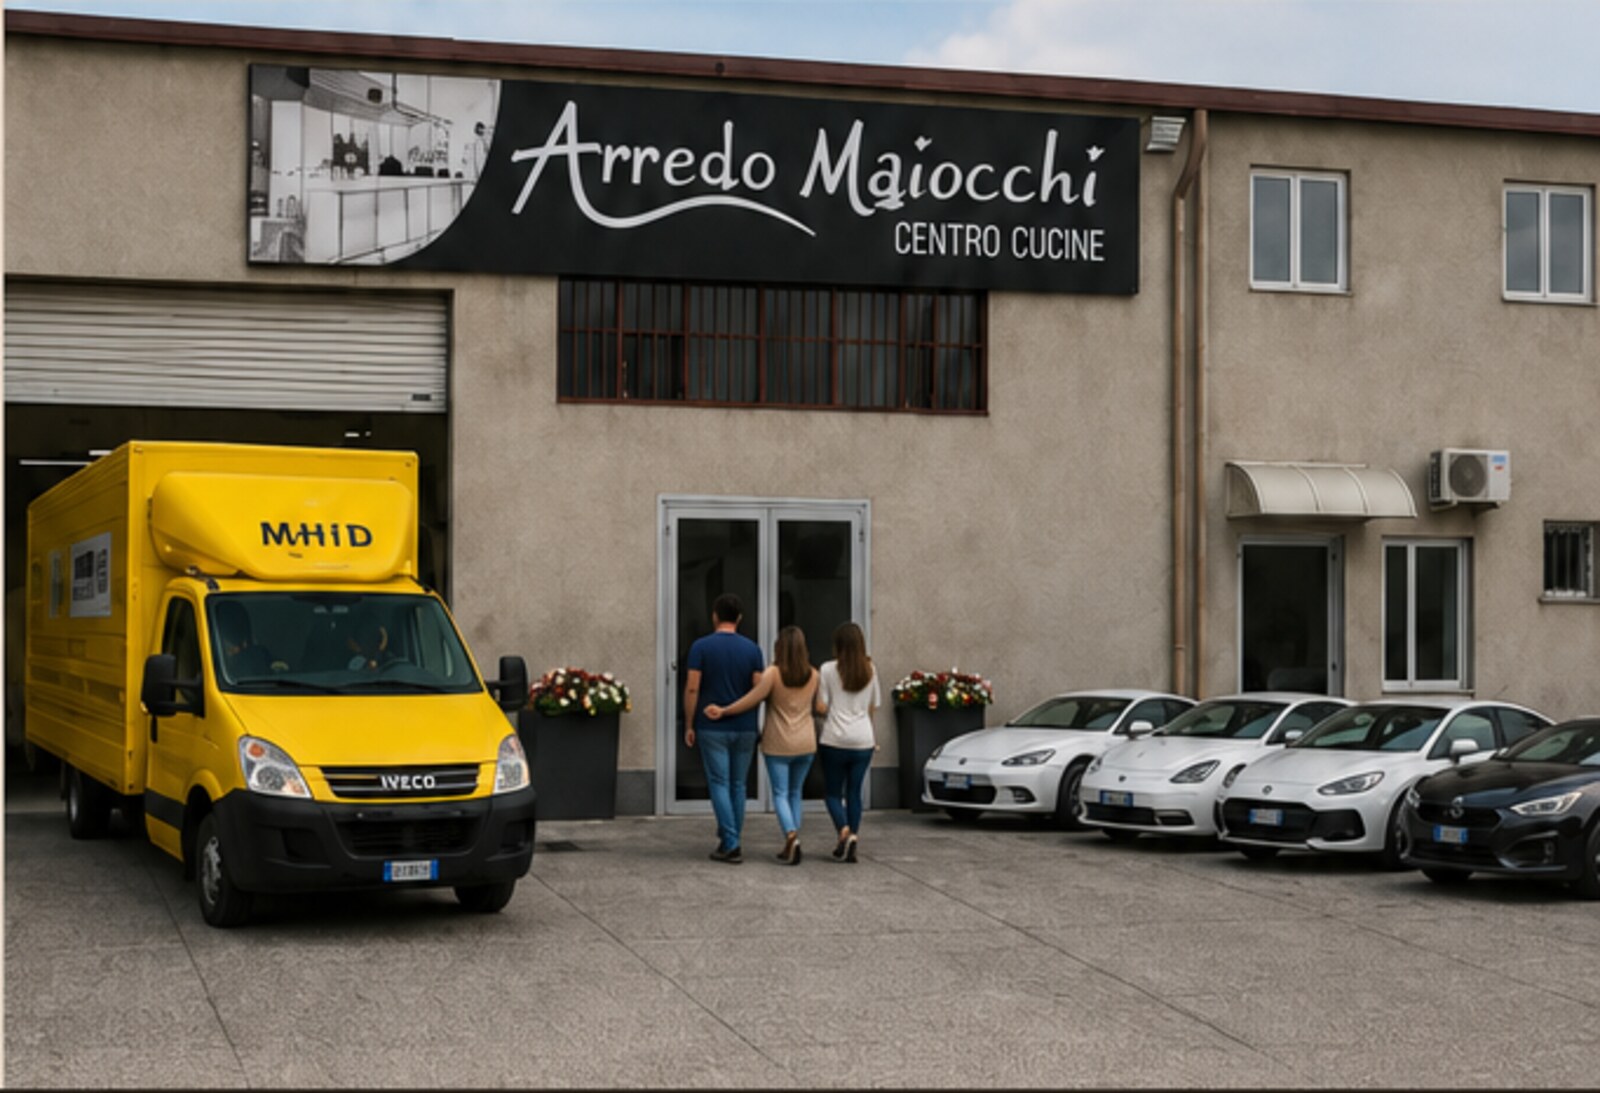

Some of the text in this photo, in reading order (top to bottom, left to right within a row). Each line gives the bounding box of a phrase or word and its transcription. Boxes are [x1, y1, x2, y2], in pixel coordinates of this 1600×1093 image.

[511, 100, 1104, 235] Arredo Maiocchi
[894, 220, 1106, 263] CENTRO CUCINE
[380, 774, 436, 790] IVECO
